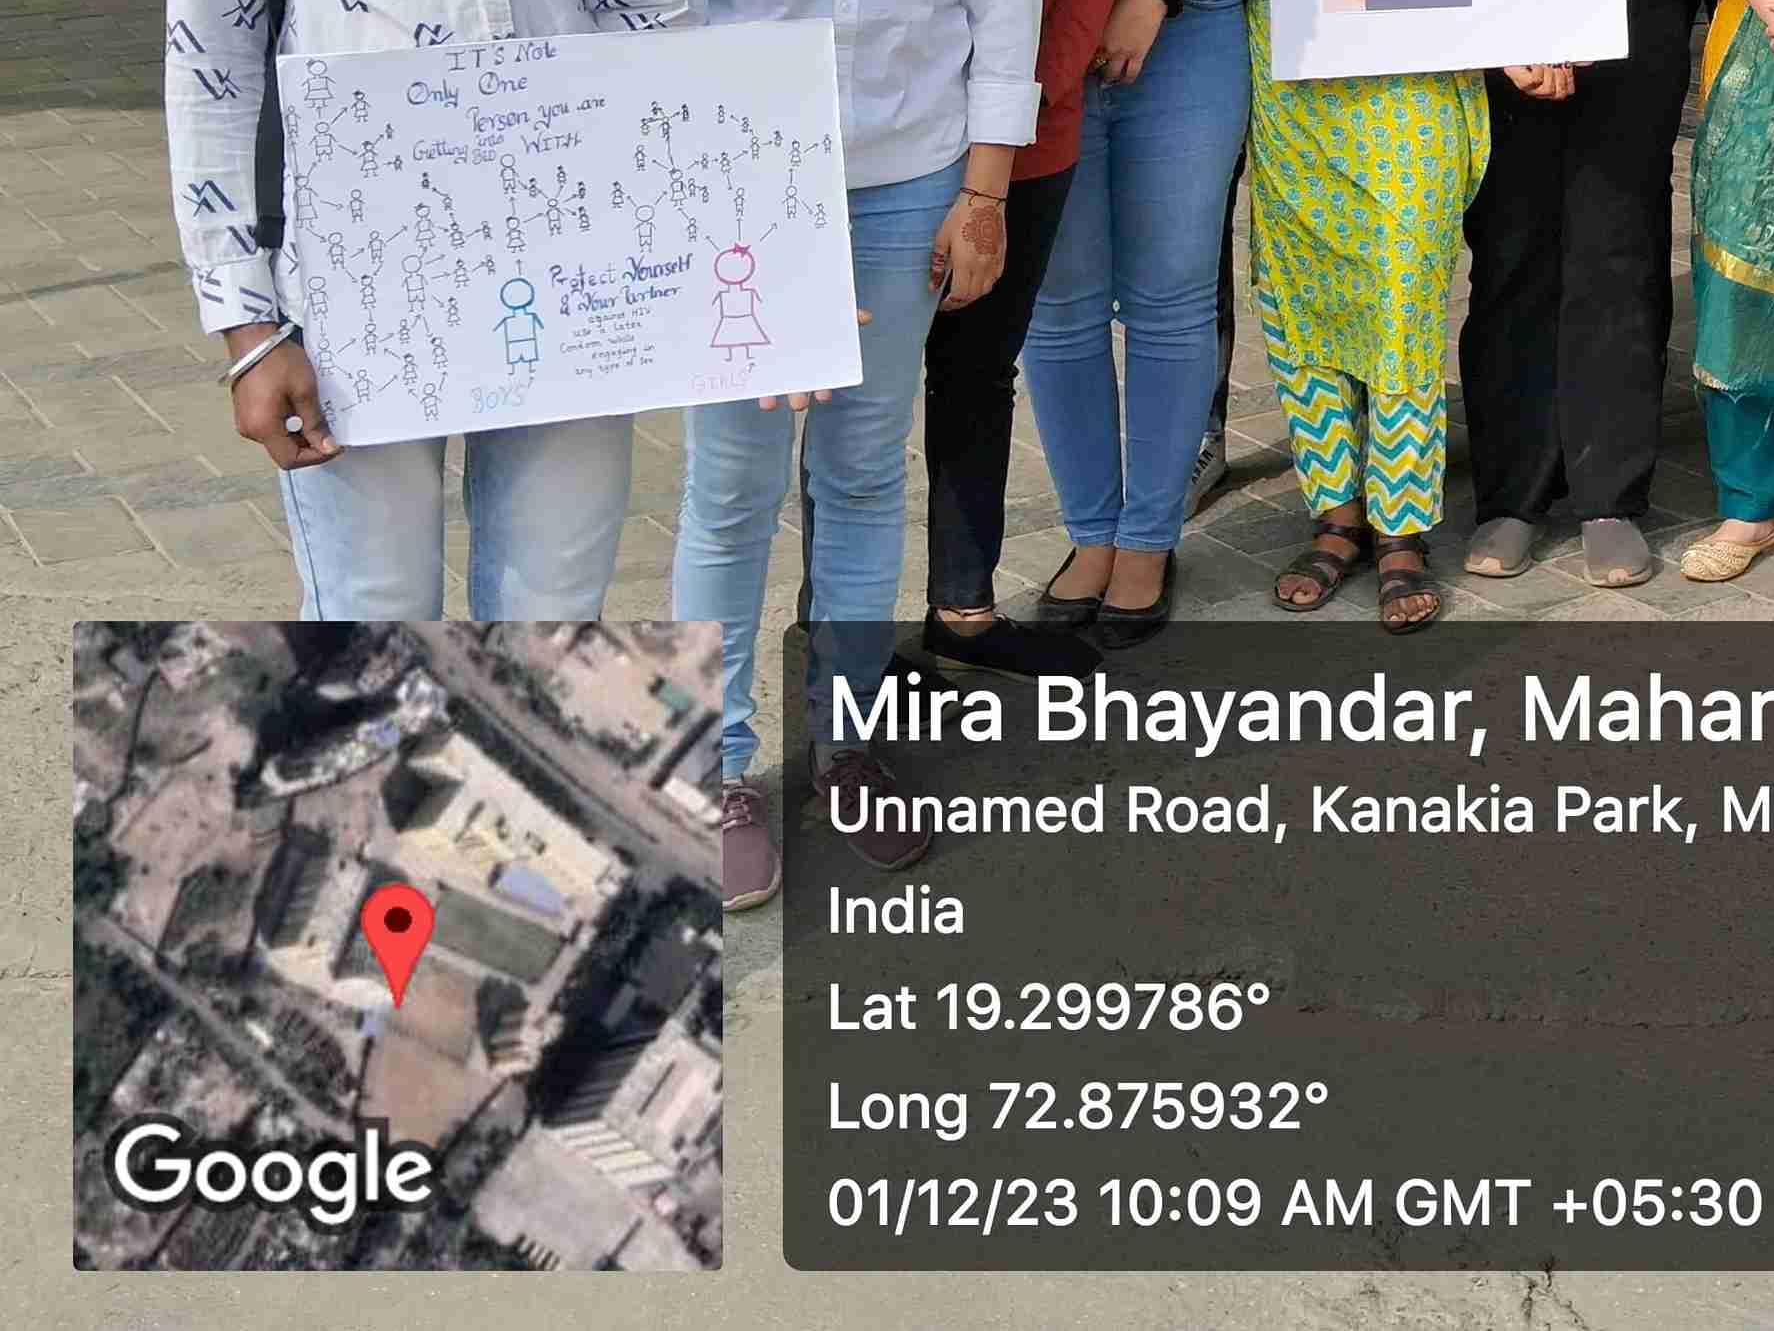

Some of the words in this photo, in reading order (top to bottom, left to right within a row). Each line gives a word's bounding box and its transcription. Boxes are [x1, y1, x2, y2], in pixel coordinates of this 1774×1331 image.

[407, 79, 460, 108] Only
[478, 71, 529, 95] One
[466, 106, 530, 133] Person
[470, 383, 525, 414] BOYS
